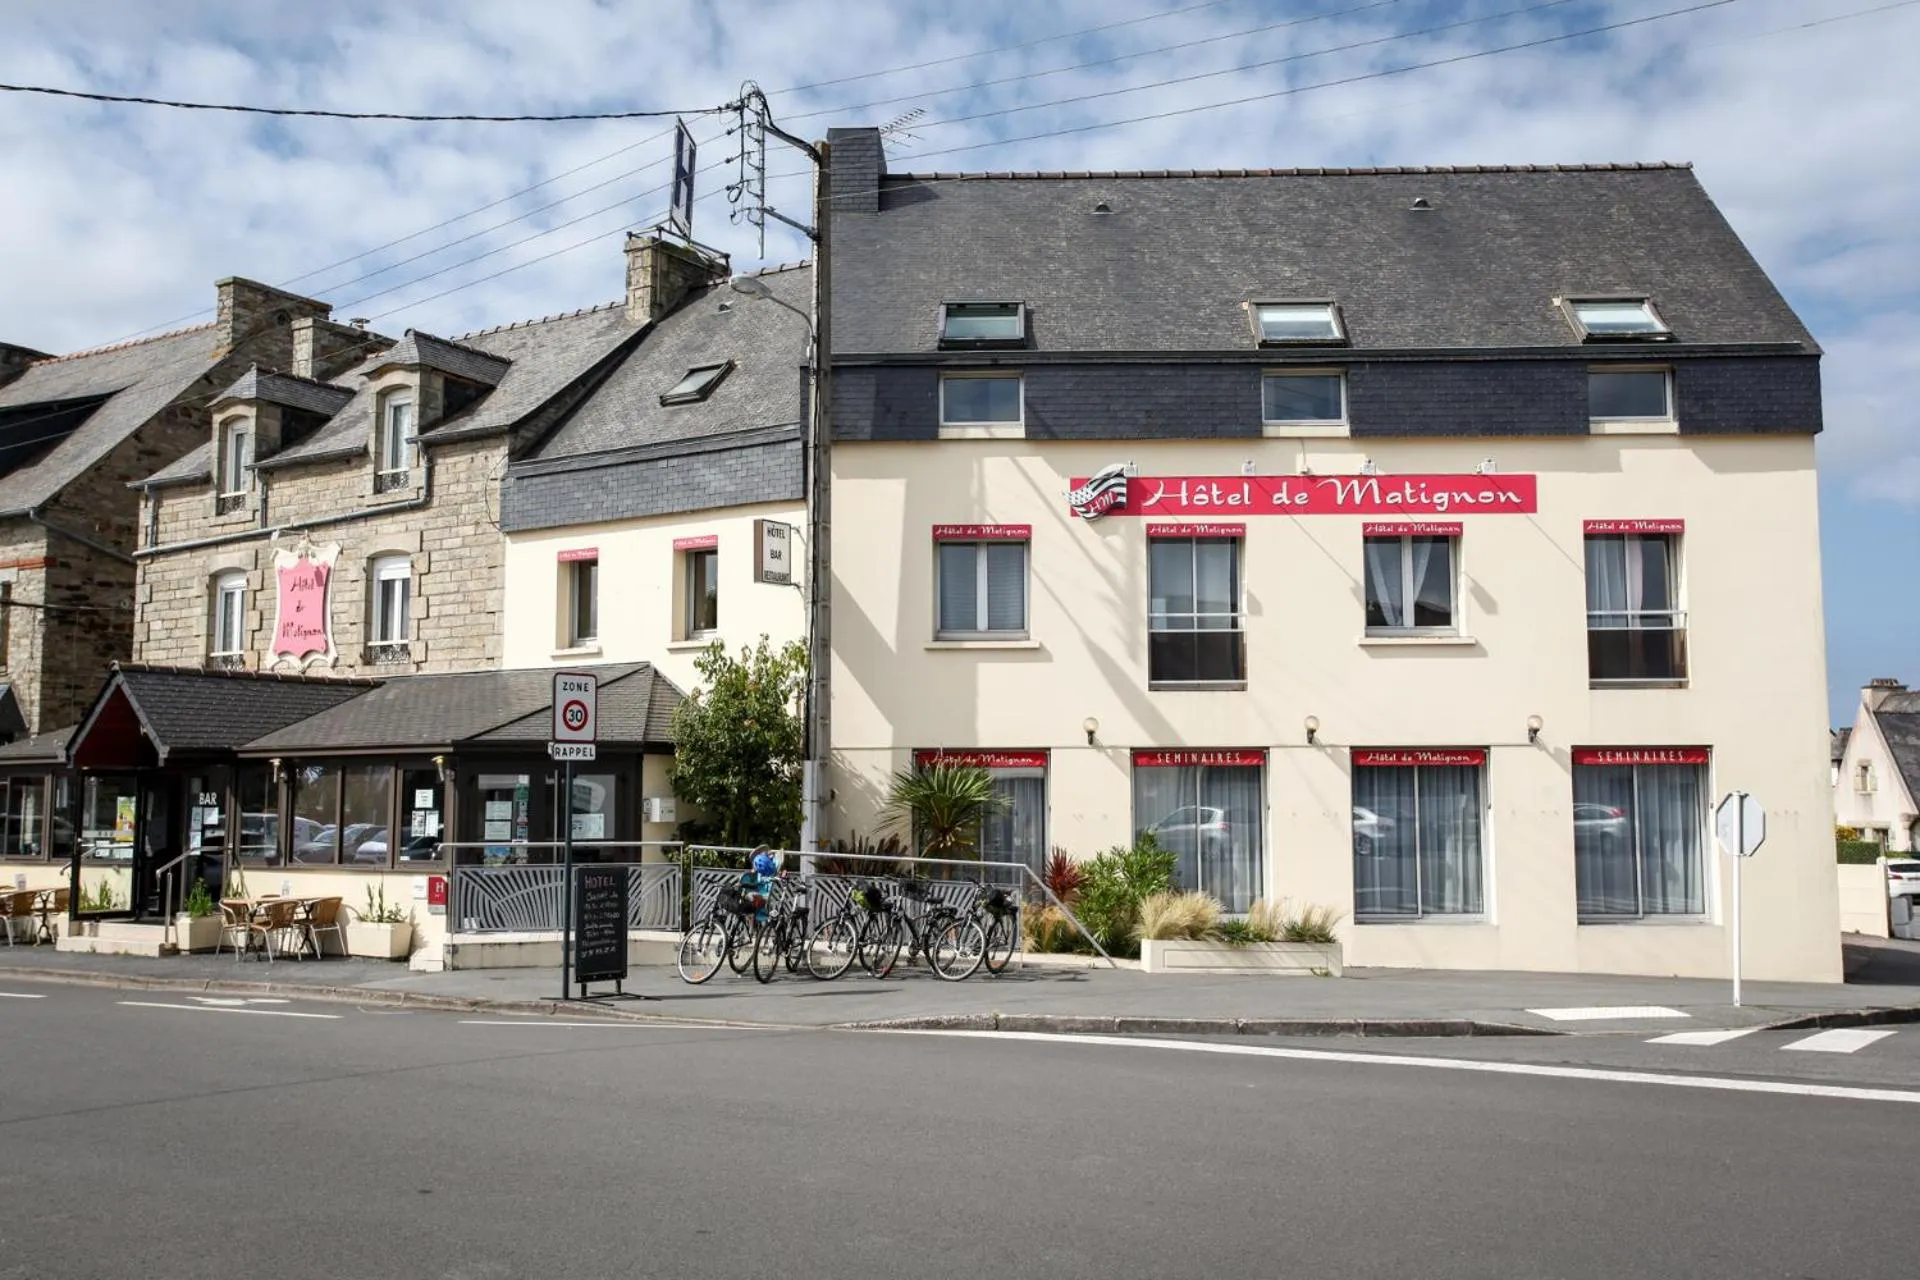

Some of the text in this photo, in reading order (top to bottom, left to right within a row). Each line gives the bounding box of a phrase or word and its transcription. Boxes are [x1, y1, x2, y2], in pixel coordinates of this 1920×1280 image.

[1143, 477, 1522, 512] Hôtel de Matignon
[935, 525, 1028, 536] Hôtel de Matignon
[1150, 524, 1243, 535] Hôtel de Matignon
[1365, 523, 1460, 534] Hôtel de Matignon
[1587, 520, 1682, 532] Hôtel de Matignon
[562, 681, 590, 692] ZONE
[568, 708, 583, 723] 30
[554, 746, 595, 758] RAPPEL
[1366, 751, 1470, 764] Hôtel de Matignon
[980, 753, 1033, 765] Matignon
[199, 791, 217, 805] BAR
[584, 875, 616, 889] HOTEL
